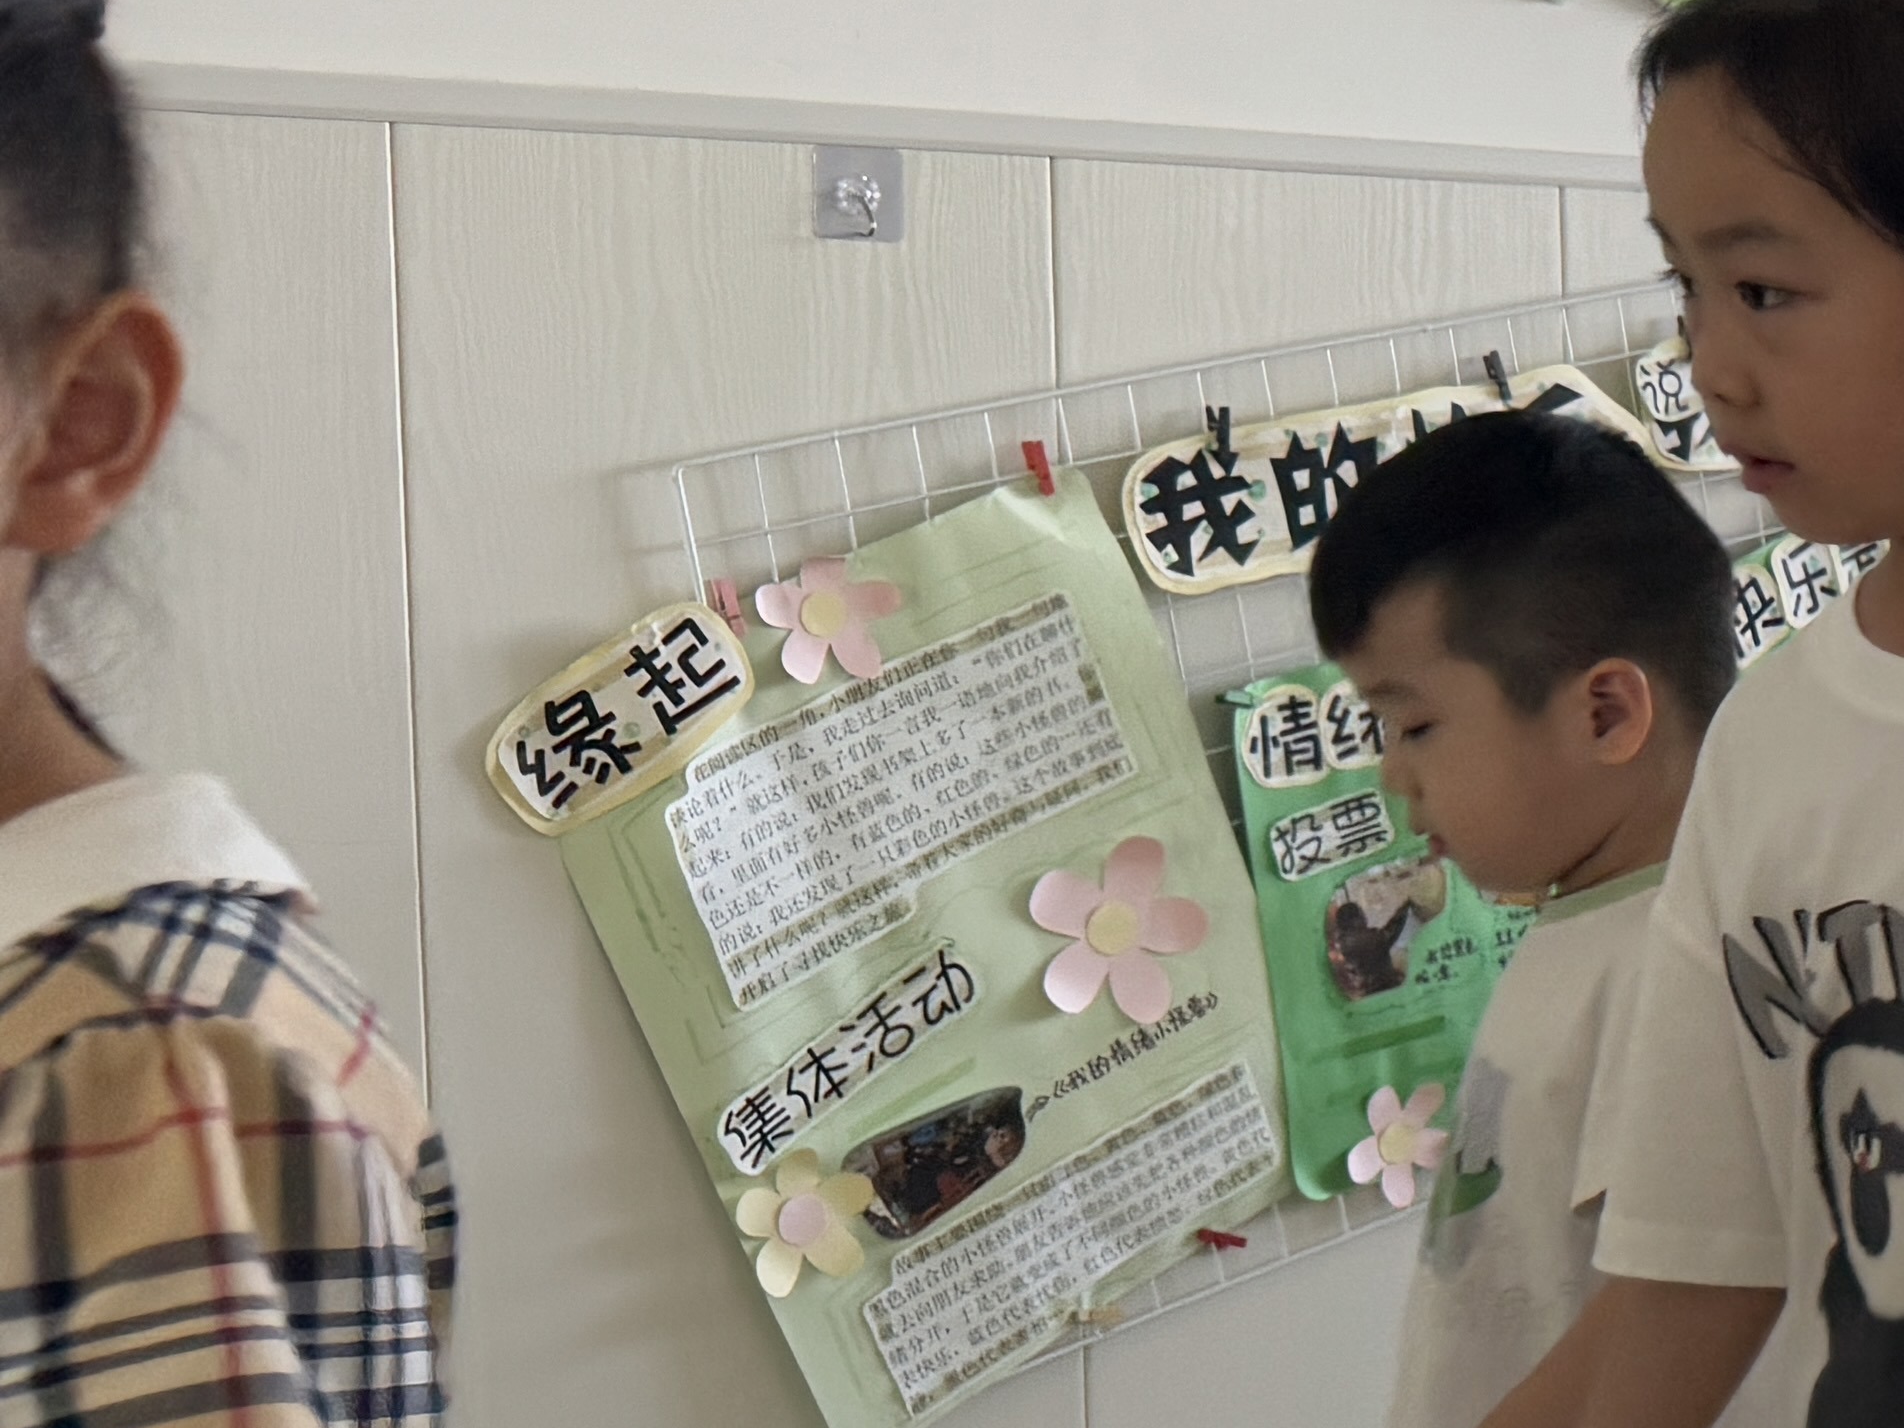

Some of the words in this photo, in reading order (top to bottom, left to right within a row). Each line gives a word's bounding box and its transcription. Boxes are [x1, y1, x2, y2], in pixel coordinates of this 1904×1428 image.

[515, 616, 741, 810] 缘起
[1274, 791, 1389, 874] 投票
[723, 950, 976, 1168] 集体活动
